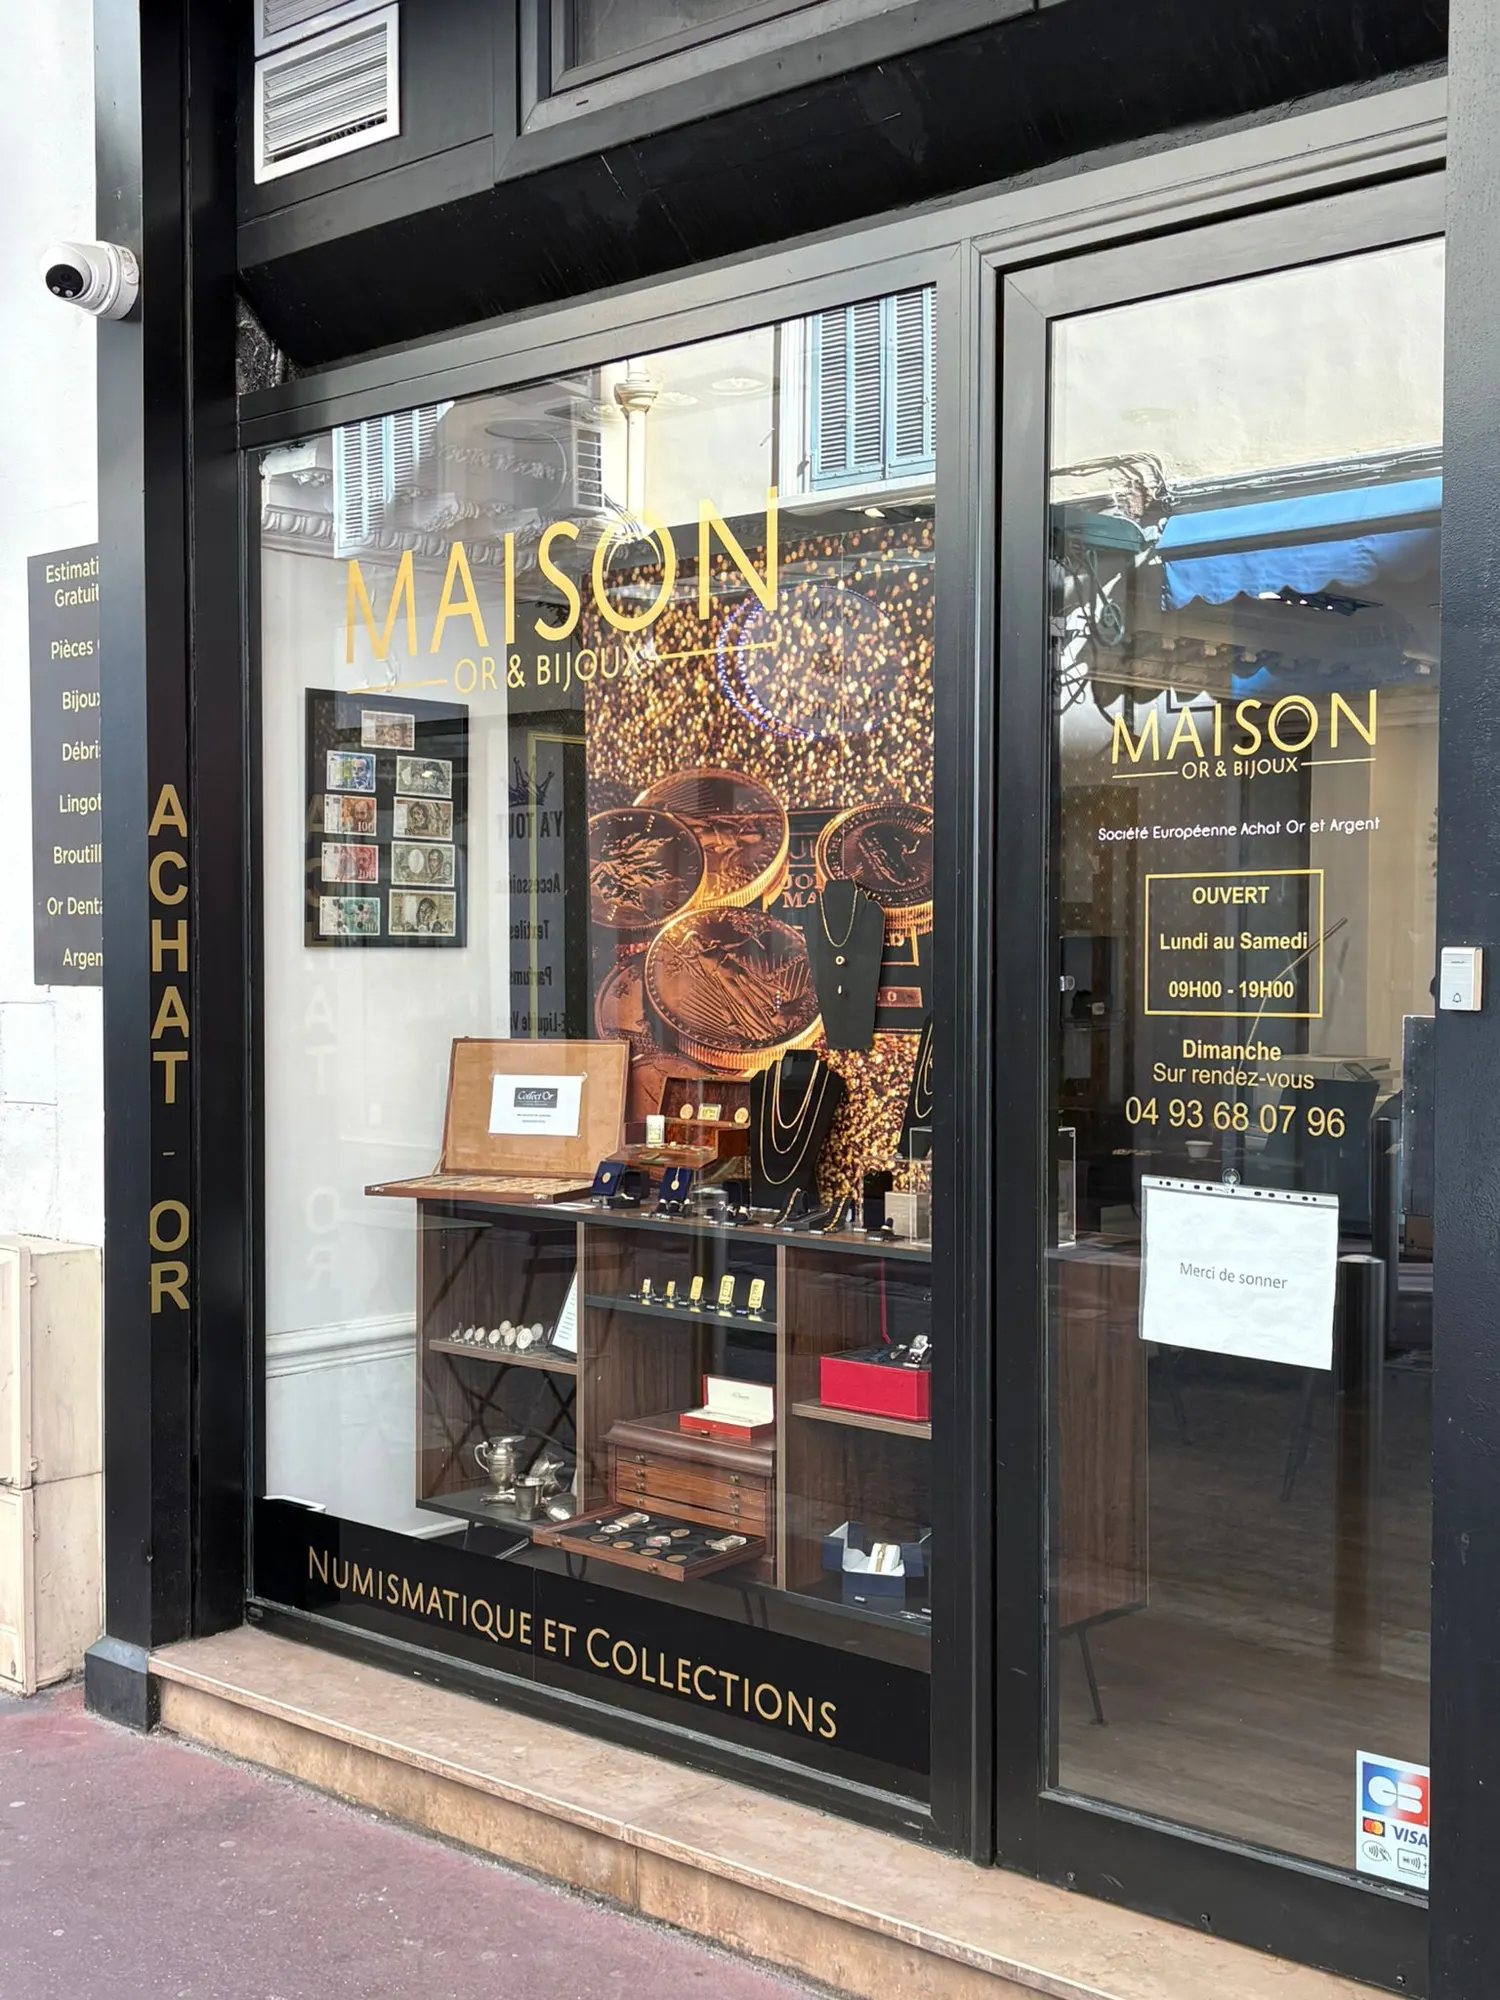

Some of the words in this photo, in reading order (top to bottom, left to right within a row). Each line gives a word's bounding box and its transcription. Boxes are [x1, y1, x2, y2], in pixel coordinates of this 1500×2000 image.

[46, 556, 99, 583] Estimati
[346, 486, 778, 664] MAISON
[50, 639, 94, 660] Pièces
[454, 656, 497, 694] OR
[506, 653, 526, 689] &
[537, 645, 642, 692] BIJOUX
[1112, 689, 1377, 764] MAISON
[1182, 759, 1210, 780] OR
[1214, 760, 1228, 777] &
[1233, 757, 1299, 779] BIJOUX
[1098, 826, 1149, 841] Société
[1153, 823, 1237, 841] Européenne
[1240, 821, 1281, 836] Achat
[1286, 819, 1306, 833] Or
[1310, 821, 1326, 833] et
[1330, 816, 1380, 835] Argent
[53, 844, 102, 864] Broutill
[46, 897, 63, 915] Or
[1192, 886, 1270, 905] OUVERT
[148, 784, 190, 1104] ACHAT
[1160, 932, 1208, 950] Lundi
[1213, 936, 1235, 950] au
[1240, 932, 1308, 950] Samedi
[62, 948, 103, 970] Argen
[1168, 981, 1222, 999] 09H00
[1239, 981, 1294, 999] 19H00
[1182, 1039, 1282, 1061] Dimanche
[1153, 1063, 1186, 1083] Sur
[1191, 1065, 1315, 1090] rendez-vous
[1125, 1096, 1159, 1125] 04
[1169, 1099, 1203, 1129] 93
[1213, 1102, 1249, 1132] 68
[1260, 1105, 1298, 1135] 07
[1307, 1107, 1345, 1138] 96
[149, 1199, 190, 1314] OR
[1179, 1262, 1216, 1280] Merci
[1219, 1268, 1235, 1282] de
[1239, 1274, 1288, 1290] sonner
[308, 1546, 532, 1643] NUMISMATIQUE
[543, 1619, 577, 1658] ET
[586, 1627, 838, 1739] COLLECTIONS
[1390, 1824, 1428, 1848] VISA
